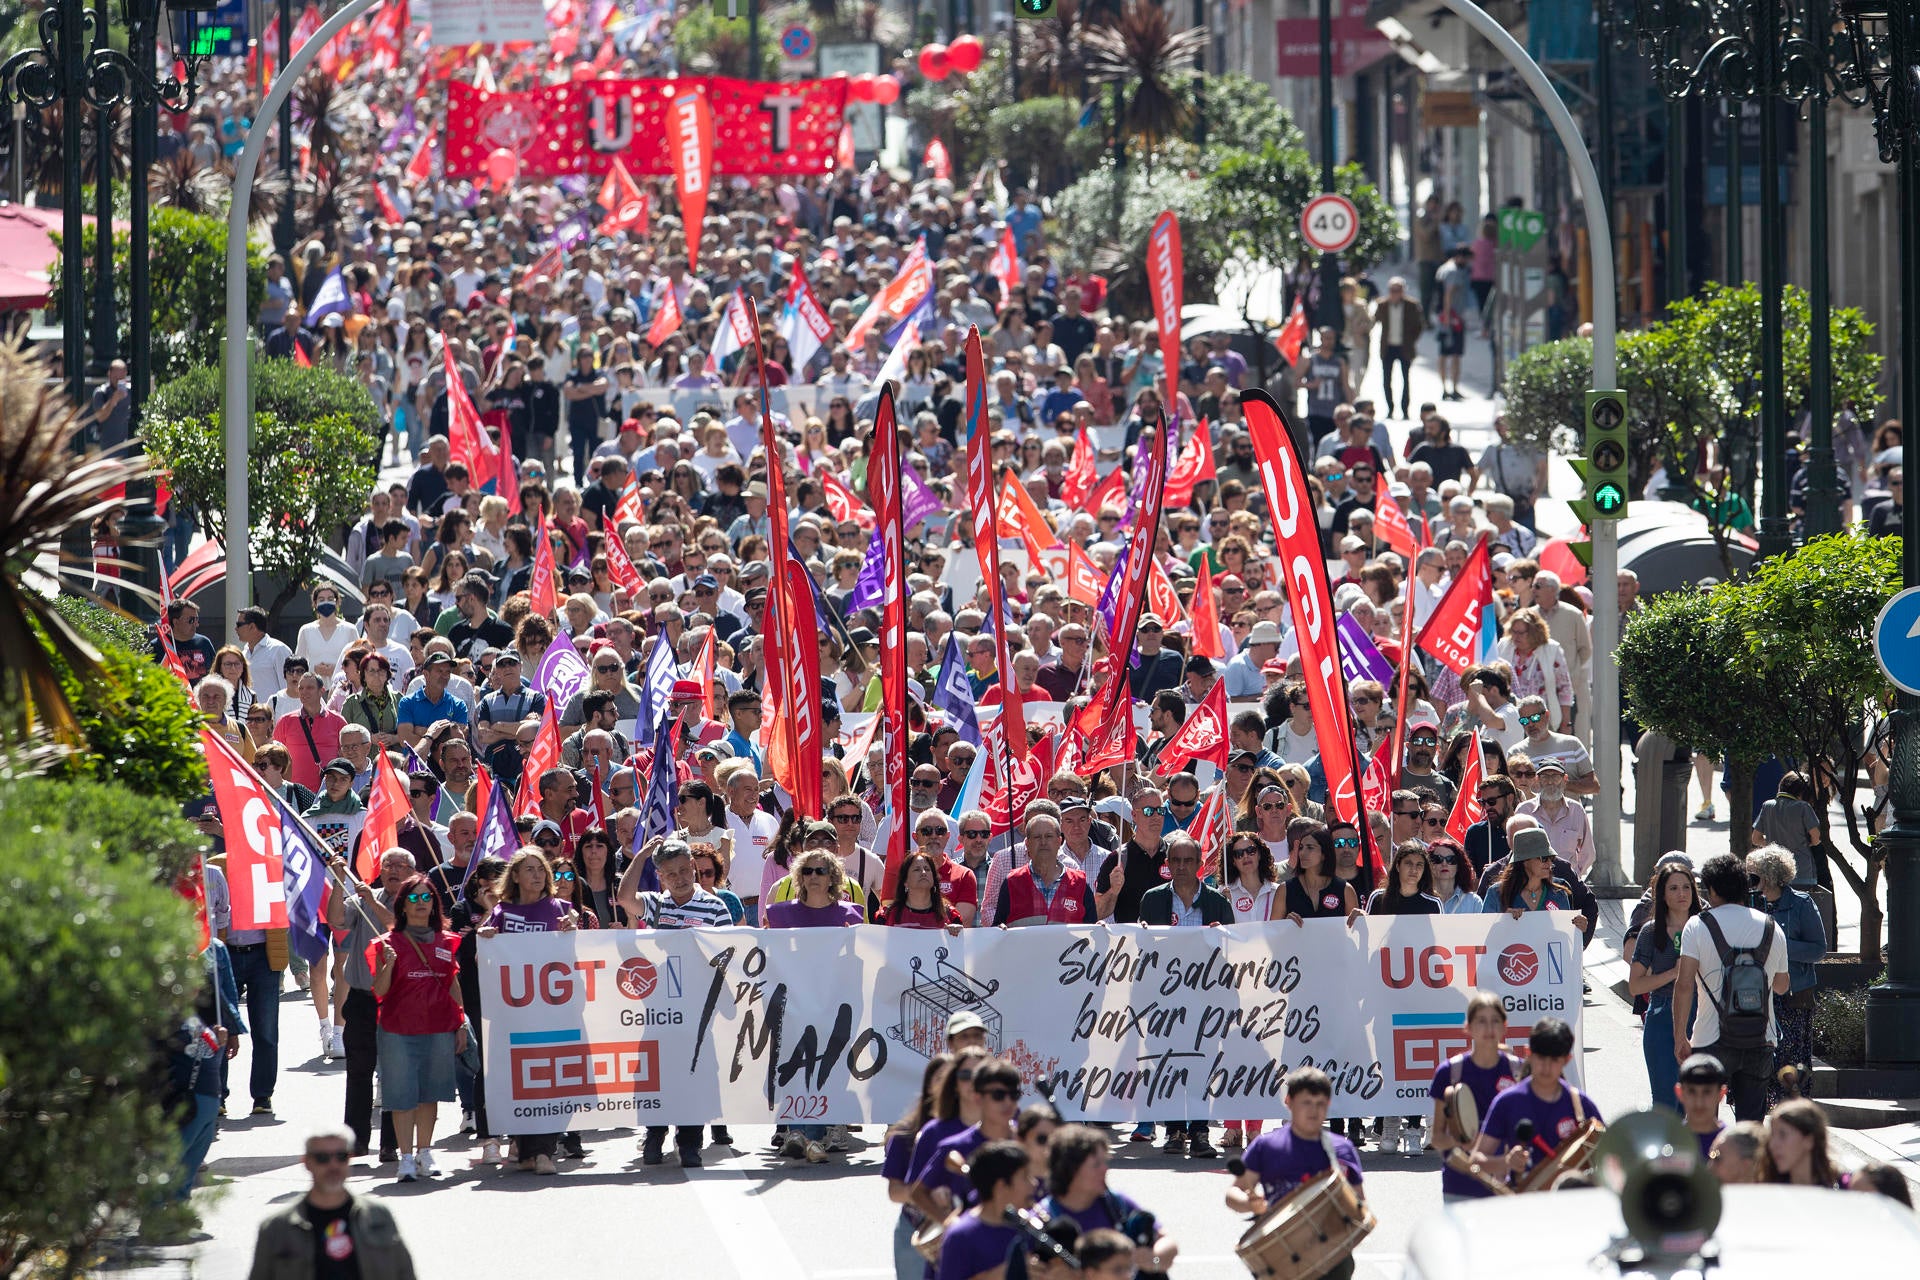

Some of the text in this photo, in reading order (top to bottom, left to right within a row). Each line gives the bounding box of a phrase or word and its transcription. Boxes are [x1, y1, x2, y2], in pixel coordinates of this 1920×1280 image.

[1314, 213, 1347, 231] 40
[1434, 637, 1471, 668] VIGO
[505, 920, 544, 933] CCOO
[1058, 936, 1301, 996] Subir salarios
[1380, 945, 1487, 989] UGT
[500, 960, 605, 1008] UGT
[734, 980, 767, 1005] DE
[620, 1009, 683, 1026] Galicia
[1502, 995, 1565, 1013] Galicia
[1071, 991, 1321, 1051] baixar prezos
[730, 983, 888, 1111] MAIO
[522, 1052, 649, 1089] CCOO
[1051, 1048, 1384, 1112] repartir benecios
[514, 1097, 661, 1118] comisións obreiras
[780, 1095, 829, 1120] 2023
